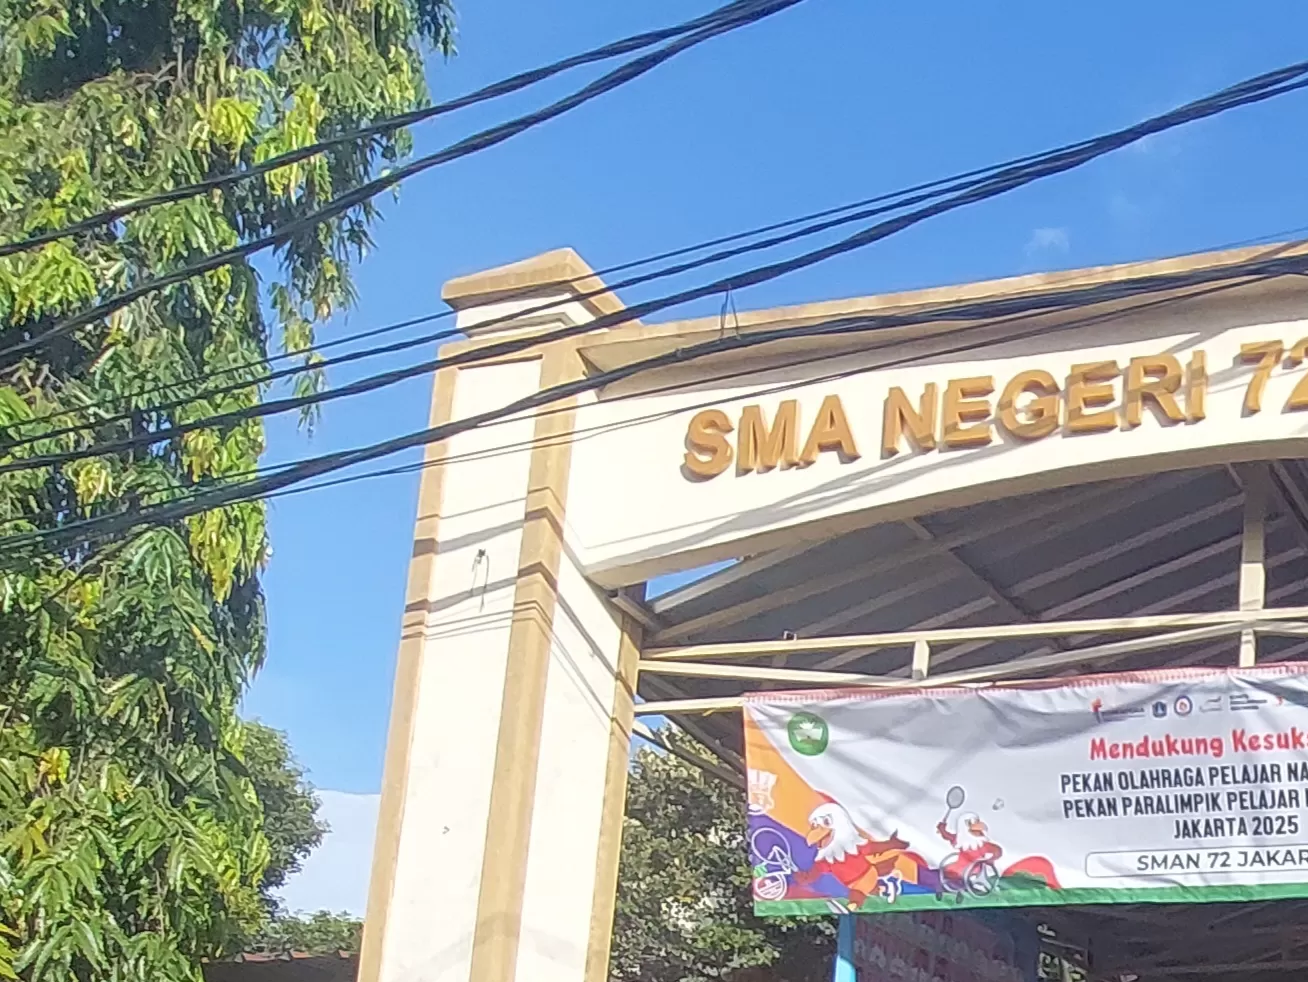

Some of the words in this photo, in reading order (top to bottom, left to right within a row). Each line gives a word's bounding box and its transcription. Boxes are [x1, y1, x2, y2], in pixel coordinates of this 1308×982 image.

[683, 394, 860, 480] SMA
[882, 349, 1208, 460] NEGERI
[1090, 734, 1223, 760] Mendukung
[1061, 772, 1114, 794] PEKAN
[1119, 766, 1203, 790] OLAHRAGA
[1208, 763, 1281, 788] PELAJAR
[1064, 797, 1118, 819] PEKAN
[1122, 791, 1222, 817] PARALIMPIK
[1227, 788, 1300, 812] PELAJAR
[1174, 817, 1248, 839] JAKARTA
[1252, 814, 1299, 836] 2025
[1137, 853, 1201, 872] SMAN
[1207, 852, 1230, 869] 72
